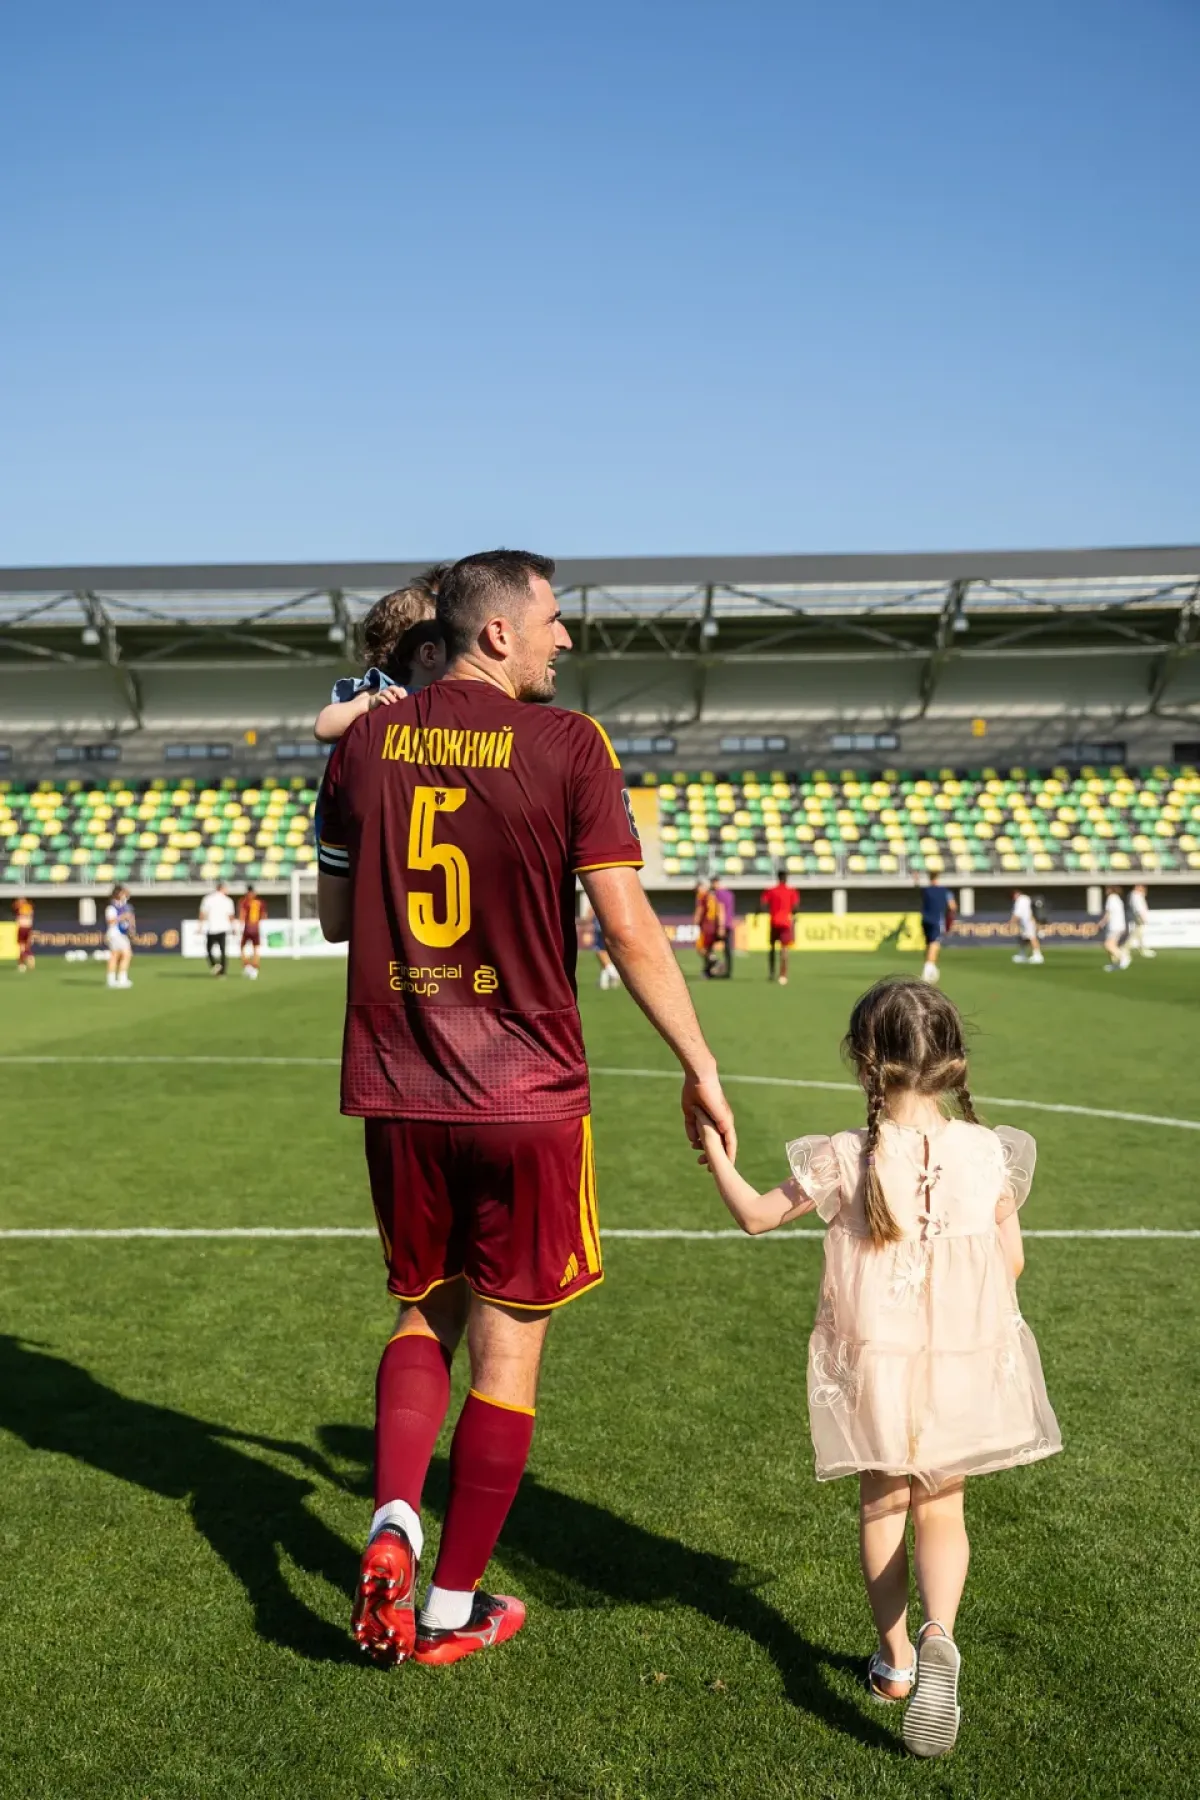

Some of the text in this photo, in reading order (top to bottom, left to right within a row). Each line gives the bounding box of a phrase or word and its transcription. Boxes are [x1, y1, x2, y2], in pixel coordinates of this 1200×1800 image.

[381, 724, 514, 769] КАЛЮЖНИЙ
[407, 785, 471, 948] 5
[950, 920, 1020, 937] Financia
[389, 960, 462, 979] Financial
[389, 975, 440, 998] Group
